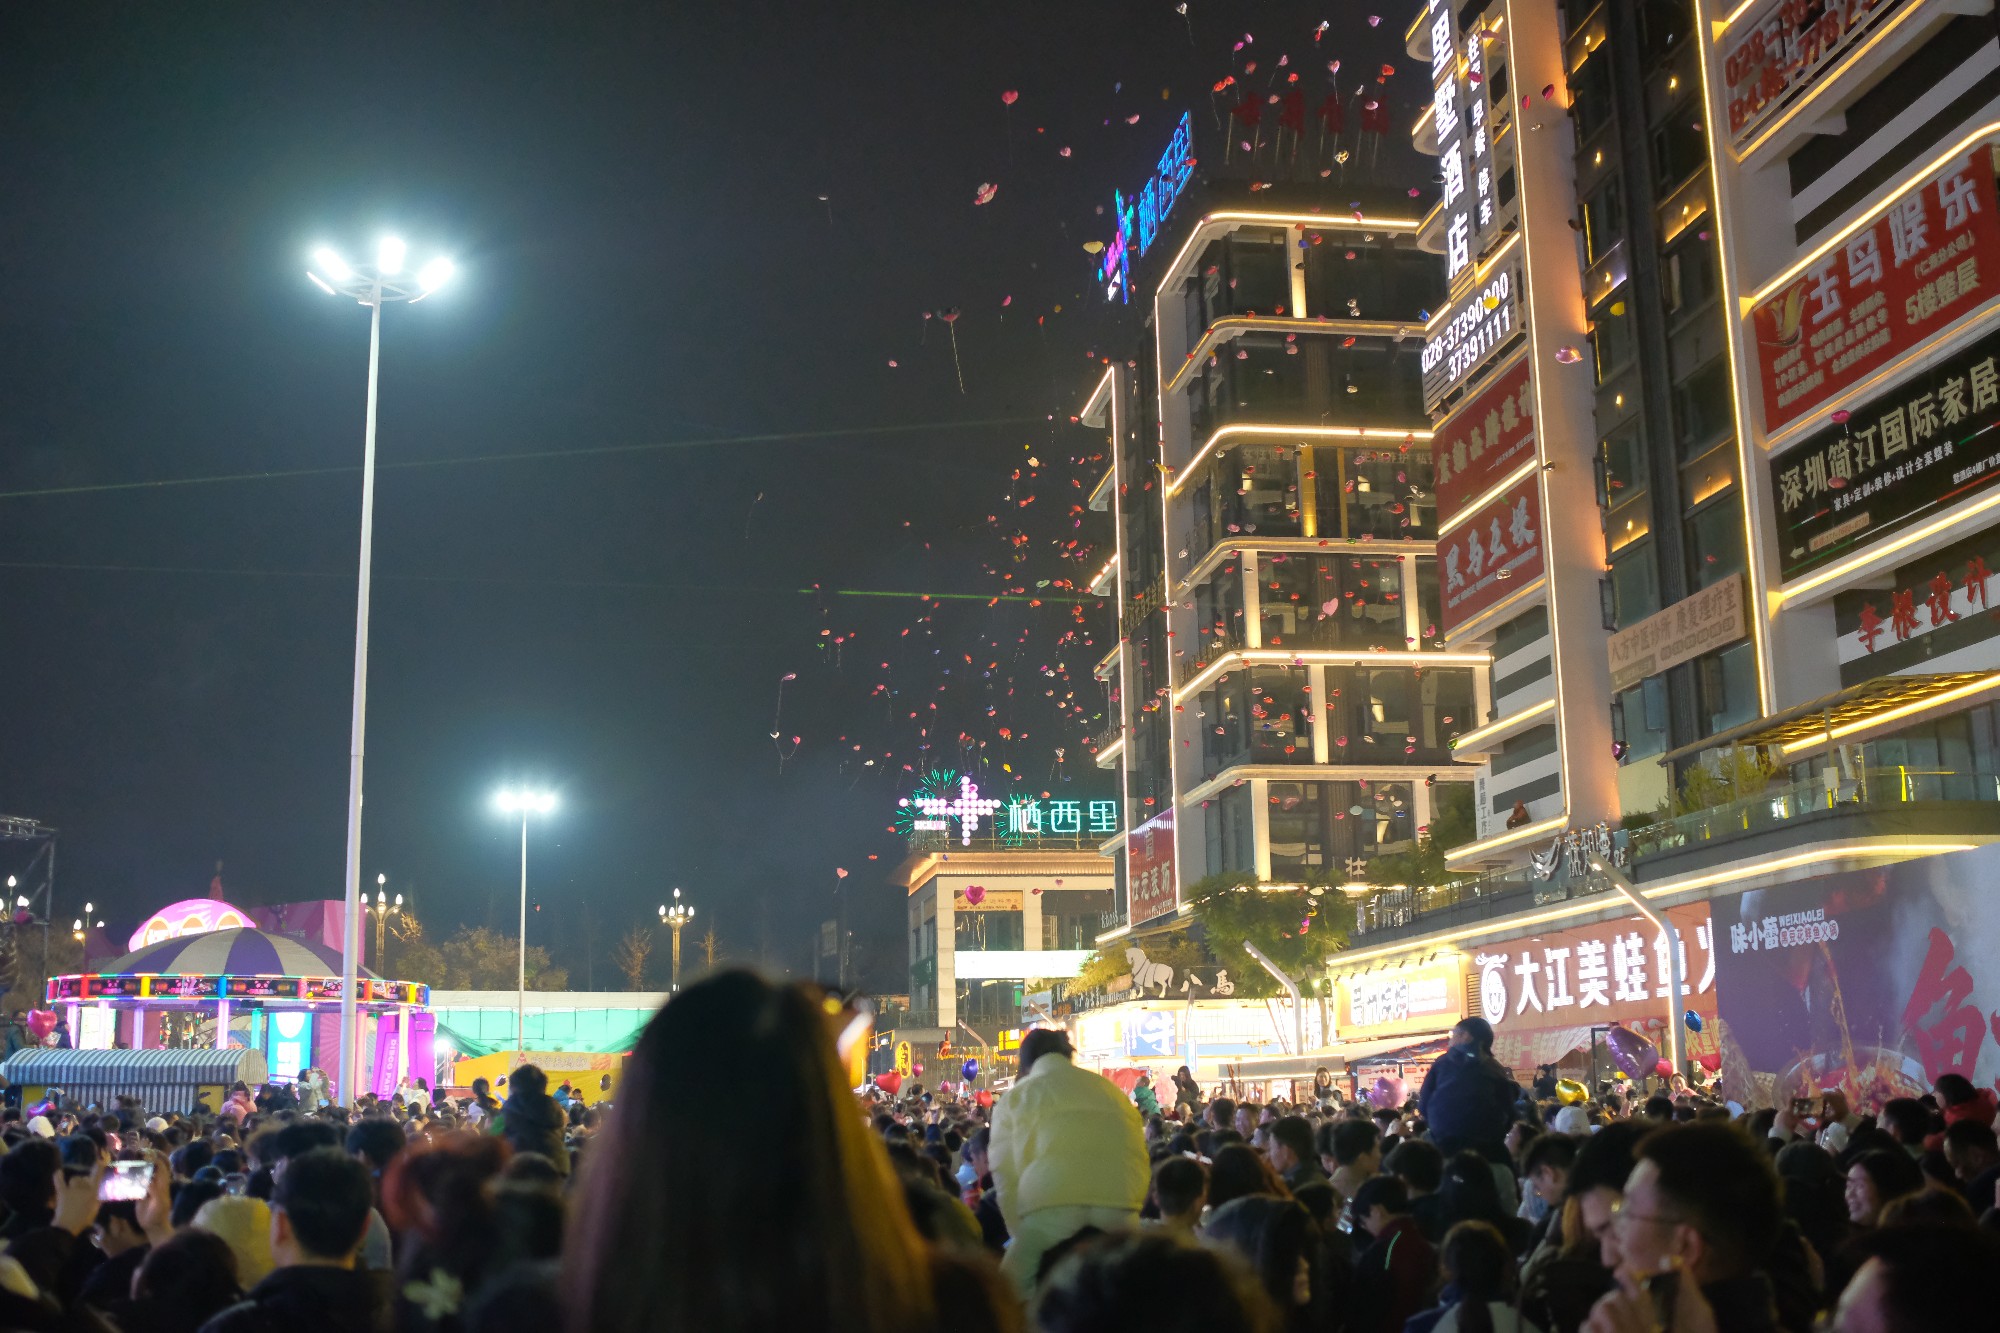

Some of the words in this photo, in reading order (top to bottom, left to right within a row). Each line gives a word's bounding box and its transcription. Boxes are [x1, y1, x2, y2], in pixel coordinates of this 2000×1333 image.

[1429, 0, 1469, 280] 里墅酒店
[1472, 98, 1487, 157] 早餐
[1478, 167, 1493, 226] 停车
[1808, 156, 1982, 325] 玉鸟娱乐
[1905, 255, 1981, 326] 5楼整层
[1448, 305, 1511, 382] 37391111
[1779, 356, 2000, 513] 深圳简汀国际家居
[1009, 799, 1117, 834] 栖西里
[1730, 916, 1779, 954] 味小蕾
[1779, 908, 1824, 928] WEIXIAOLEI
